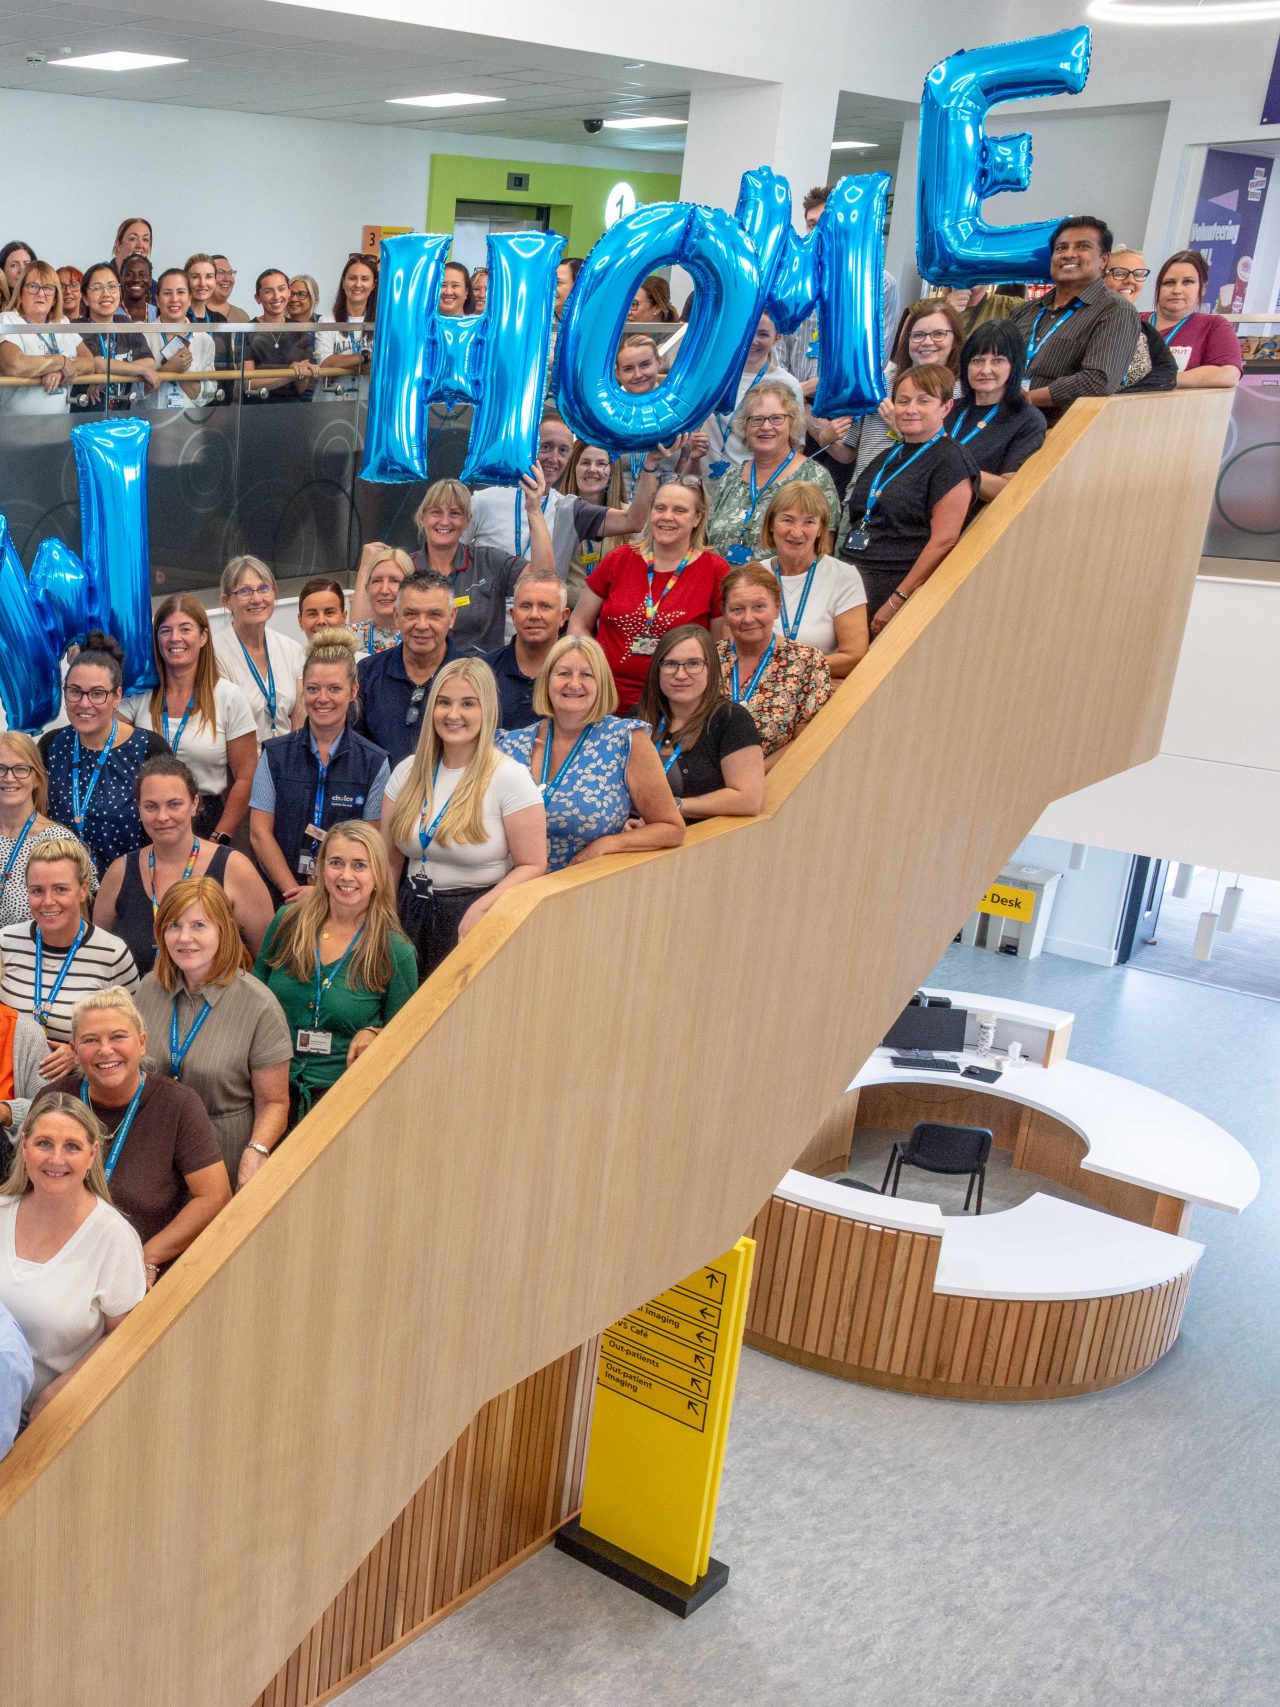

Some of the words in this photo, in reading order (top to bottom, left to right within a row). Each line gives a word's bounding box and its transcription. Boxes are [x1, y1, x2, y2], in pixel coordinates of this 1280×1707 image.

[615, 194, 624, 220] 1
[369, 232, 376, 246] 3
[1190, 219, 1240, 245] Volunteering
[990, 893, 1022, 909] Desk
[645, 1307, 680, 1329] Imaging
[630, 1325, 648, 1338] Café
[608, 1340, 659, 1368] Out-patients
[605, 1371, 638, 1392] Imaging
[606, 1362, 652, 1389] Out-patient
